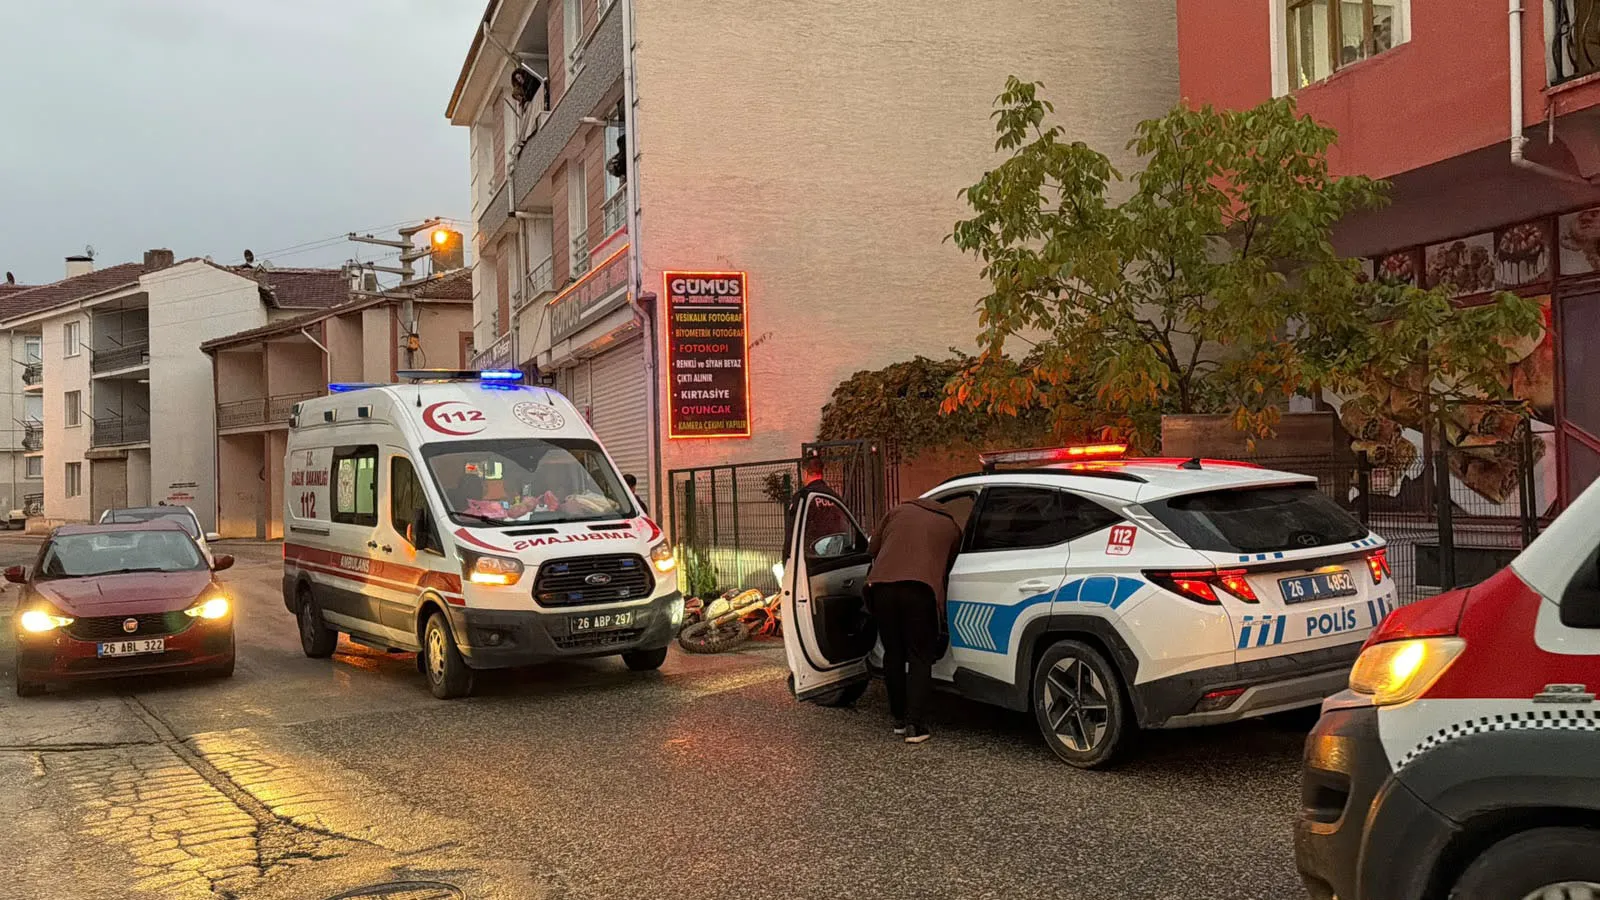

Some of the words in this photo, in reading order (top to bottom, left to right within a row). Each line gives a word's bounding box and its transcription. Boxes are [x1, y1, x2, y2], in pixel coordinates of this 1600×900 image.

[675, 311, 707, 322] VESİKALIK
[708, 311, 742, 322] FOTOĞRAF
[676, 327, 711, 338] BİYOMETRİK
[676, 357, 697, 368] RENKLİ
[705, 357, 723, 368] SİYAH
[723, 359, 742, 368] BEYAZ
[677, 373, 693, 385] ÇIKTI
[693, 373, 713, 383] ALINIR
[681, 387, 730, 399] KIRTASİYE
[681, 405, 731, 415] OYUNCAK
[437, 410, 486, 423] 112
[679, 420, 703, 430] KAMERA
[301, 491, 316, 518] 112
[1113, 528, 1132, 544] 112
[1288, 580, 1304, 597] 26
[1311, 578, 1320, 594] A
[1326, 573, 1353, 592] 4852
[577, 617, 590, 630] 26
[594, 615, 611, 628] ABP
[615, 611, 631, 625] 297
[1306, 606, 1357, 637] POLİS
[103, 643, 116, 654] 26
[121, 641, 139, 653] ABL
[144, 640, 162, 651] 322
